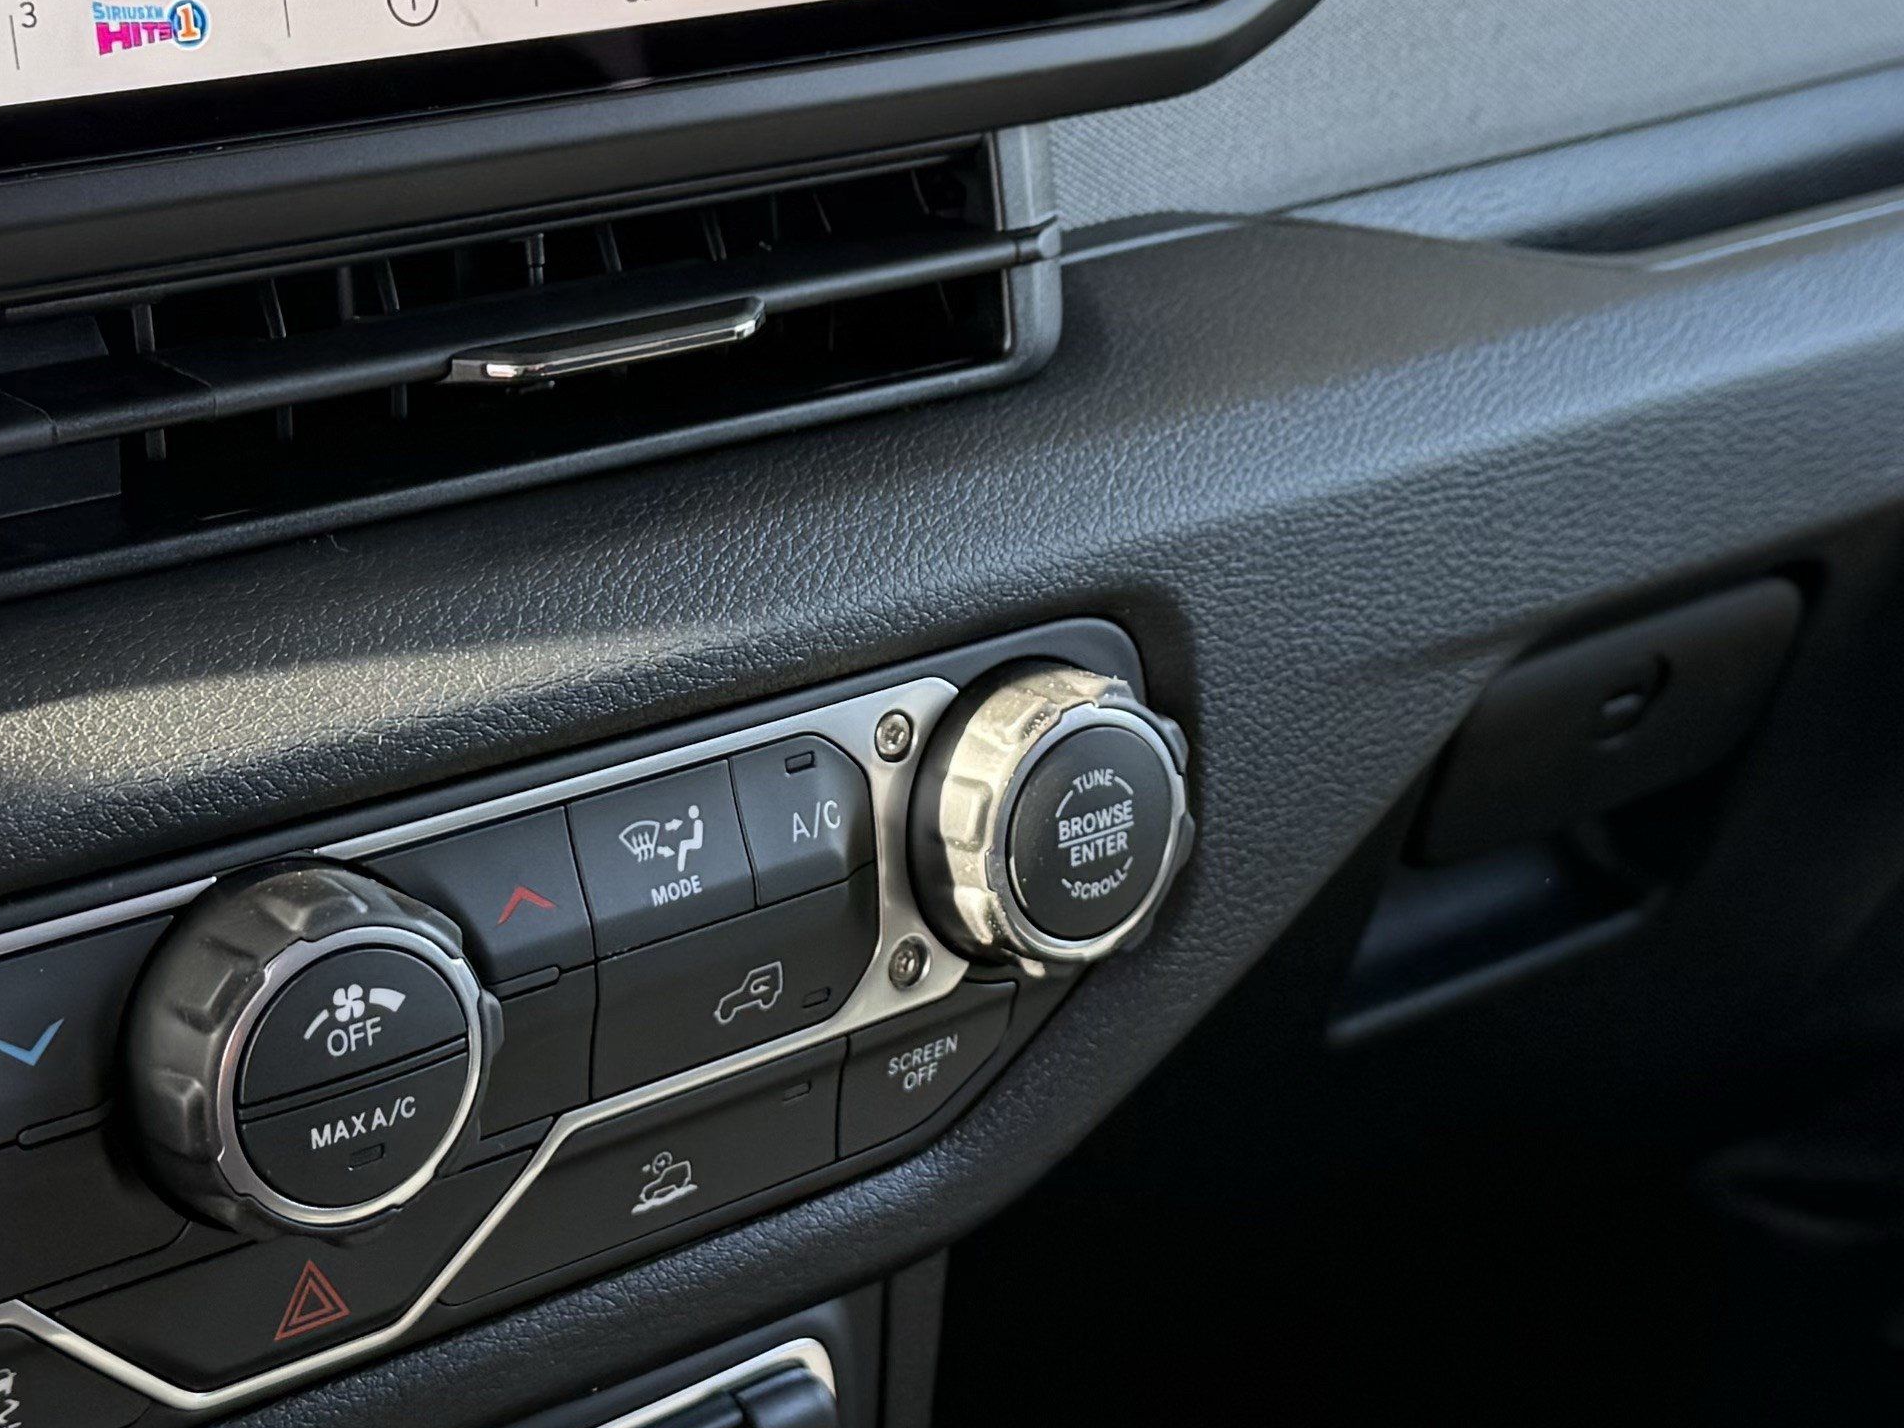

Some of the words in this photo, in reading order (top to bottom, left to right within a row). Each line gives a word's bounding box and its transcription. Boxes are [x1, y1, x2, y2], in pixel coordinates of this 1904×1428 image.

[21, 2, 38, 29] 3
[96, 21, 173, 55] HITS
[177, 3, 201, 41] 1
[1072, 767, 1115, 794] TUNE
[792, 799, 842, 841] A/C
[1058, 800, 1134, 842] BROWSE
[1070, 831, 1129, 867] ENTER
[650, 874, 703, 907] MODE
[1070, 869, 1126, 899] SCROLL
[327, 1017, 382, 1058] OFF
[888, 1033, 959, 1077] SCREEN
[903, 1061, 939, 1091] OFF
[310, 1113, 367, 1151] MAX
[370, 1094, 418, 1130] A/C
